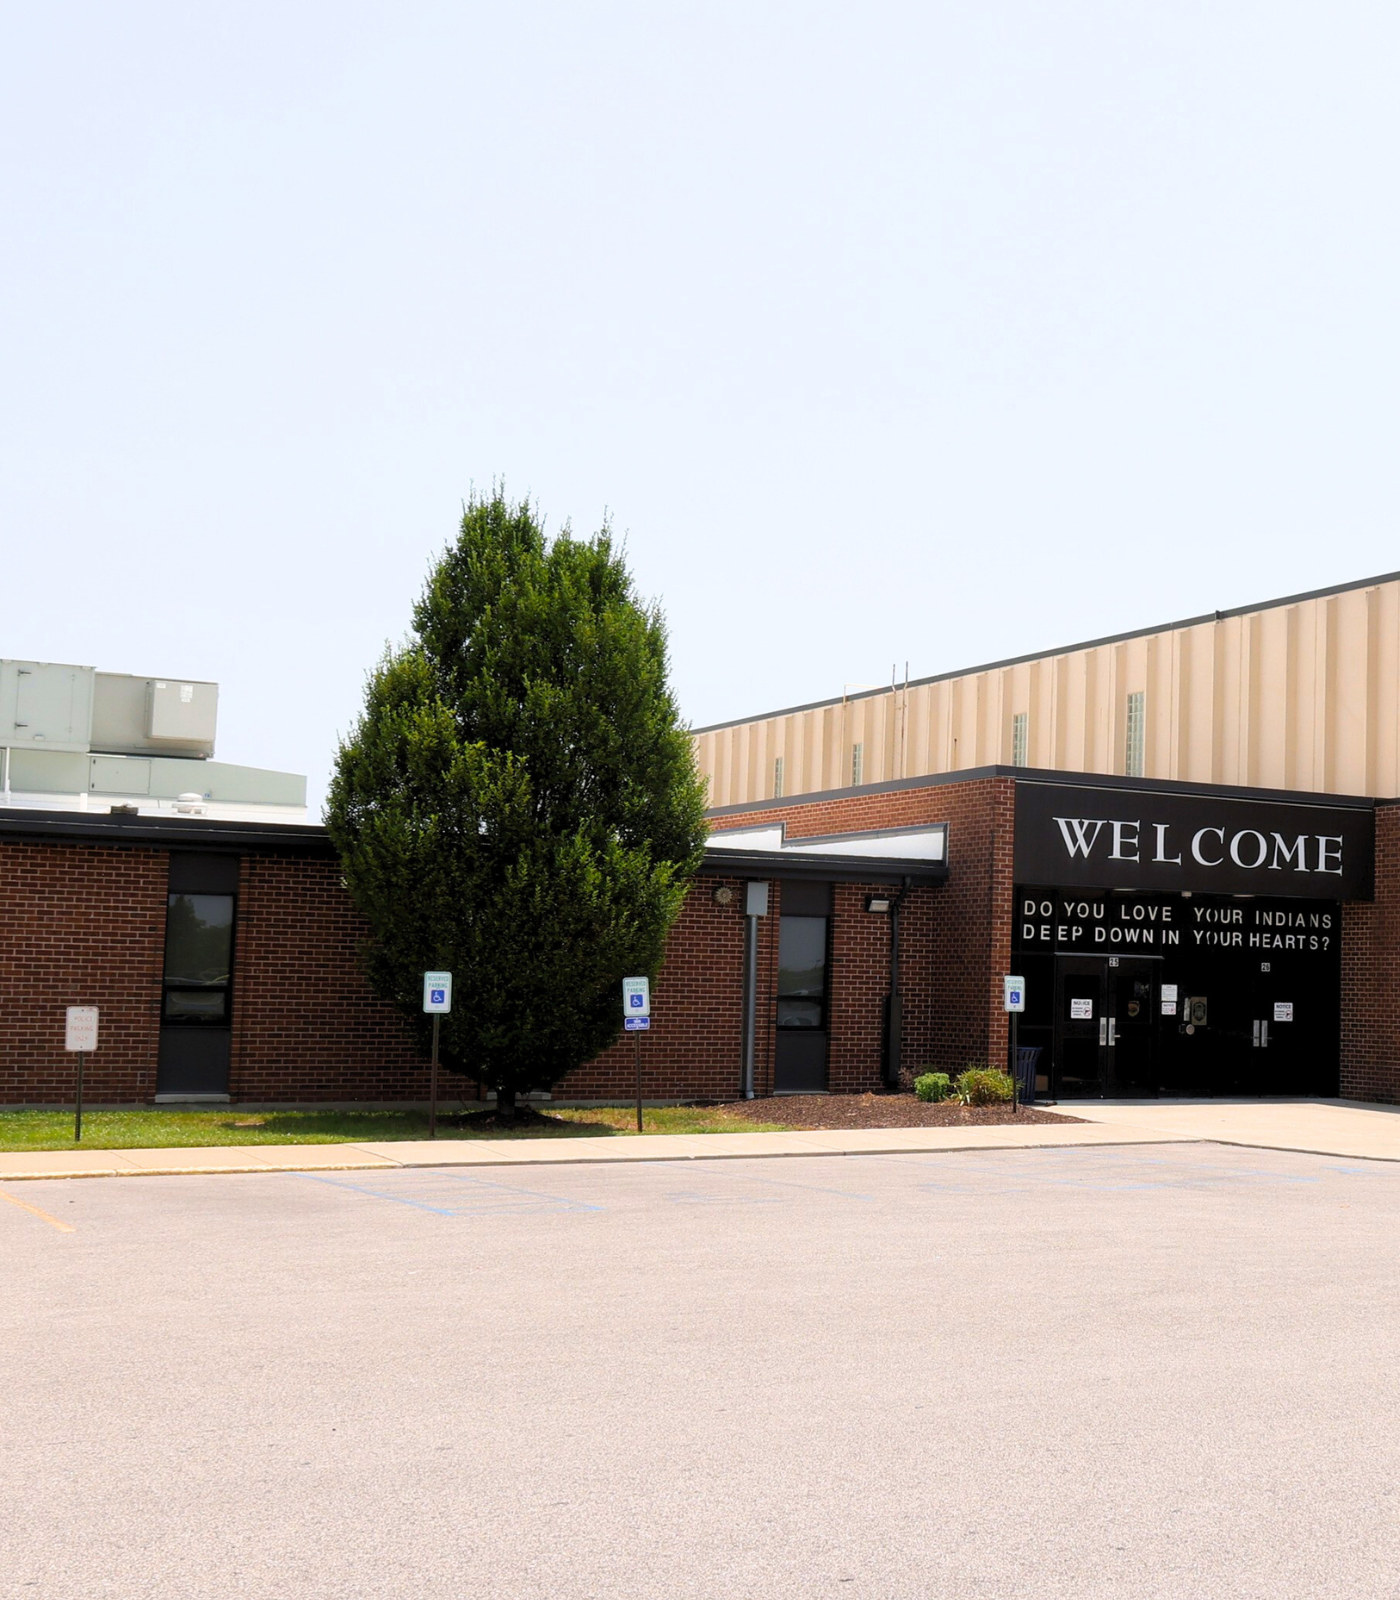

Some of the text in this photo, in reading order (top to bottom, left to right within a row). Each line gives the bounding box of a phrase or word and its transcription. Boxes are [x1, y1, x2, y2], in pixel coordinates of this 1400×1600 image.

[1052, 816, 1343, 877] WELCOME
[1024, 900, 1332, 929] DO YOU LOVE YOUR INDIANS
[1023, 924, 1330, 951] DEEP DOWN IN YOUR HEARTS?
[1109, 957, 1119, 967] 25
